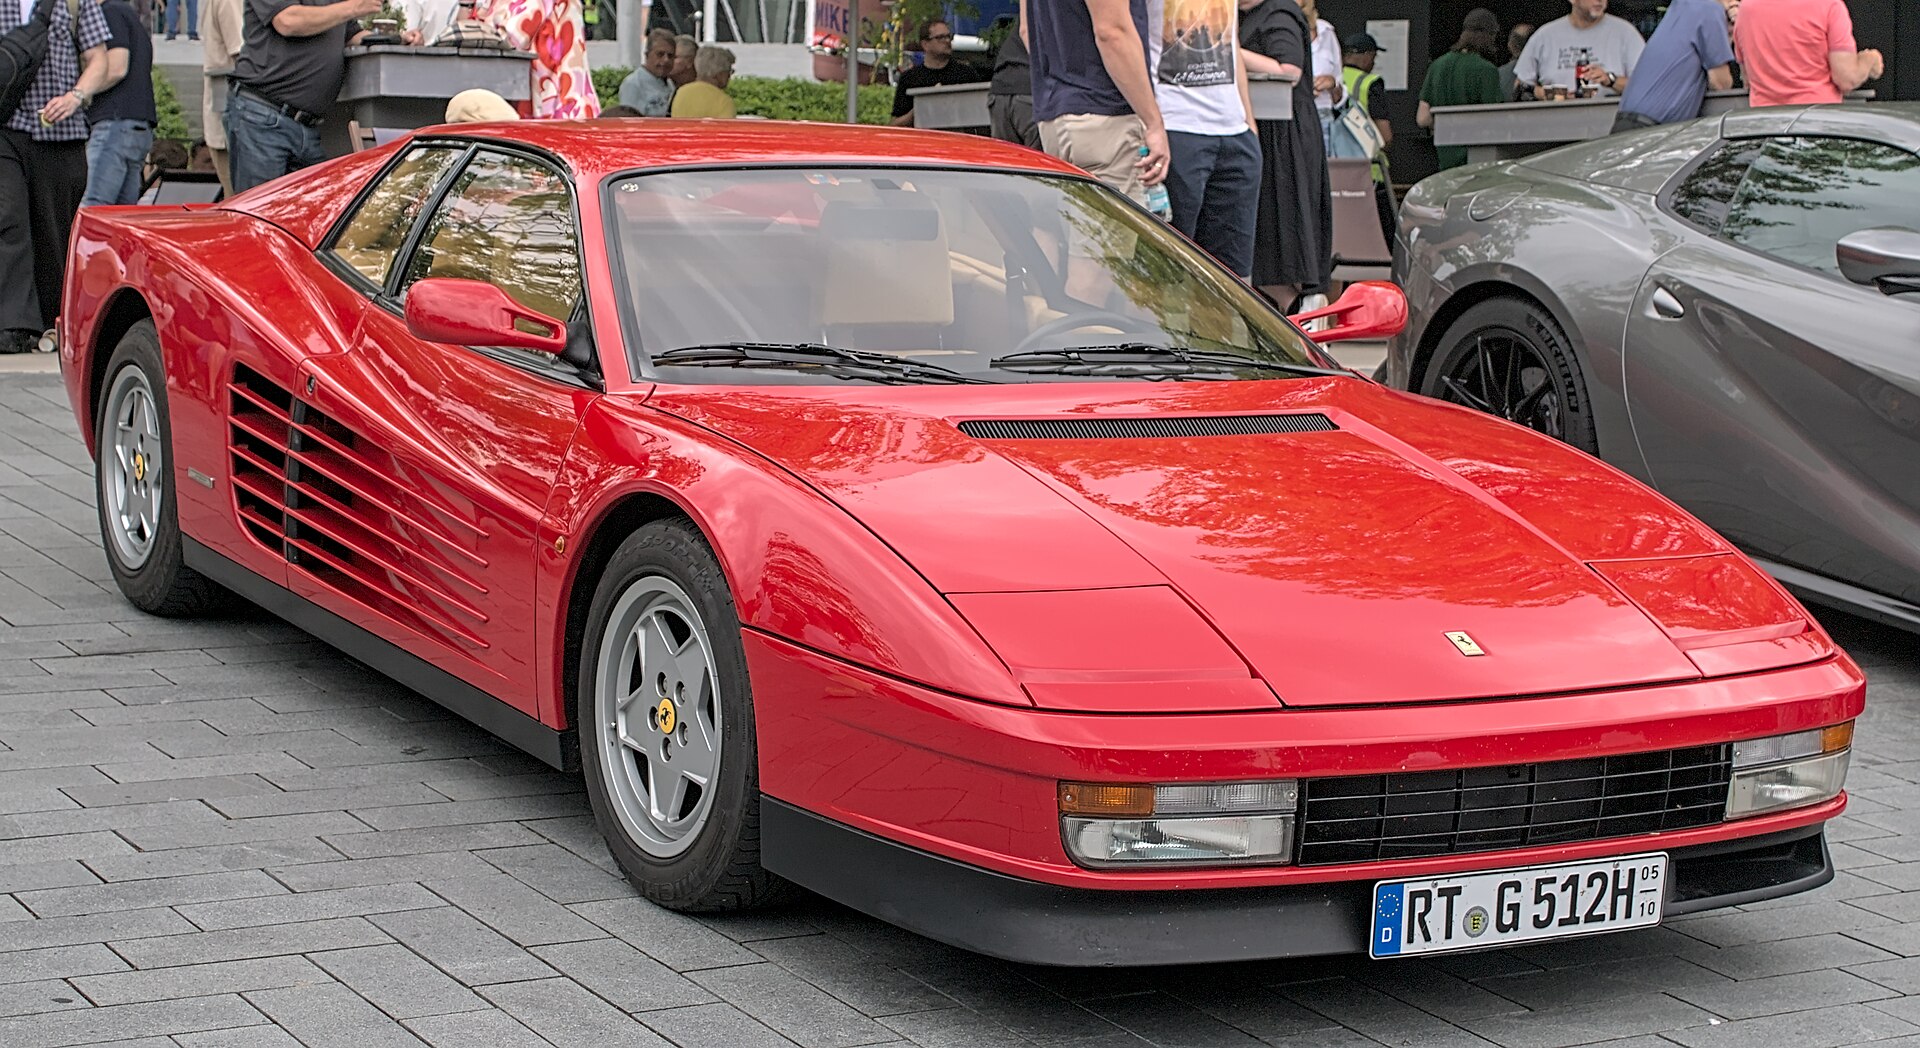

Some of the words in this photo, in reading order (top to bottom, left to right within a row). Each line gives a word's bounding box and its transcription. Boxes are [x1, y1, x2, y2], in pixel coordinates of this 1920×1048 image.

[1538, 322, 1578, 409] MICHELIN
[1641, 864, 1659, 880] 05
[1406, 885, 1462, 943] RT
[1495, 880, 1522, 933] G
[1532, 867, 1636, 929] 512H
[1639, 901, 1656, 917] 10
[1381, 927, 1392, 943] D
